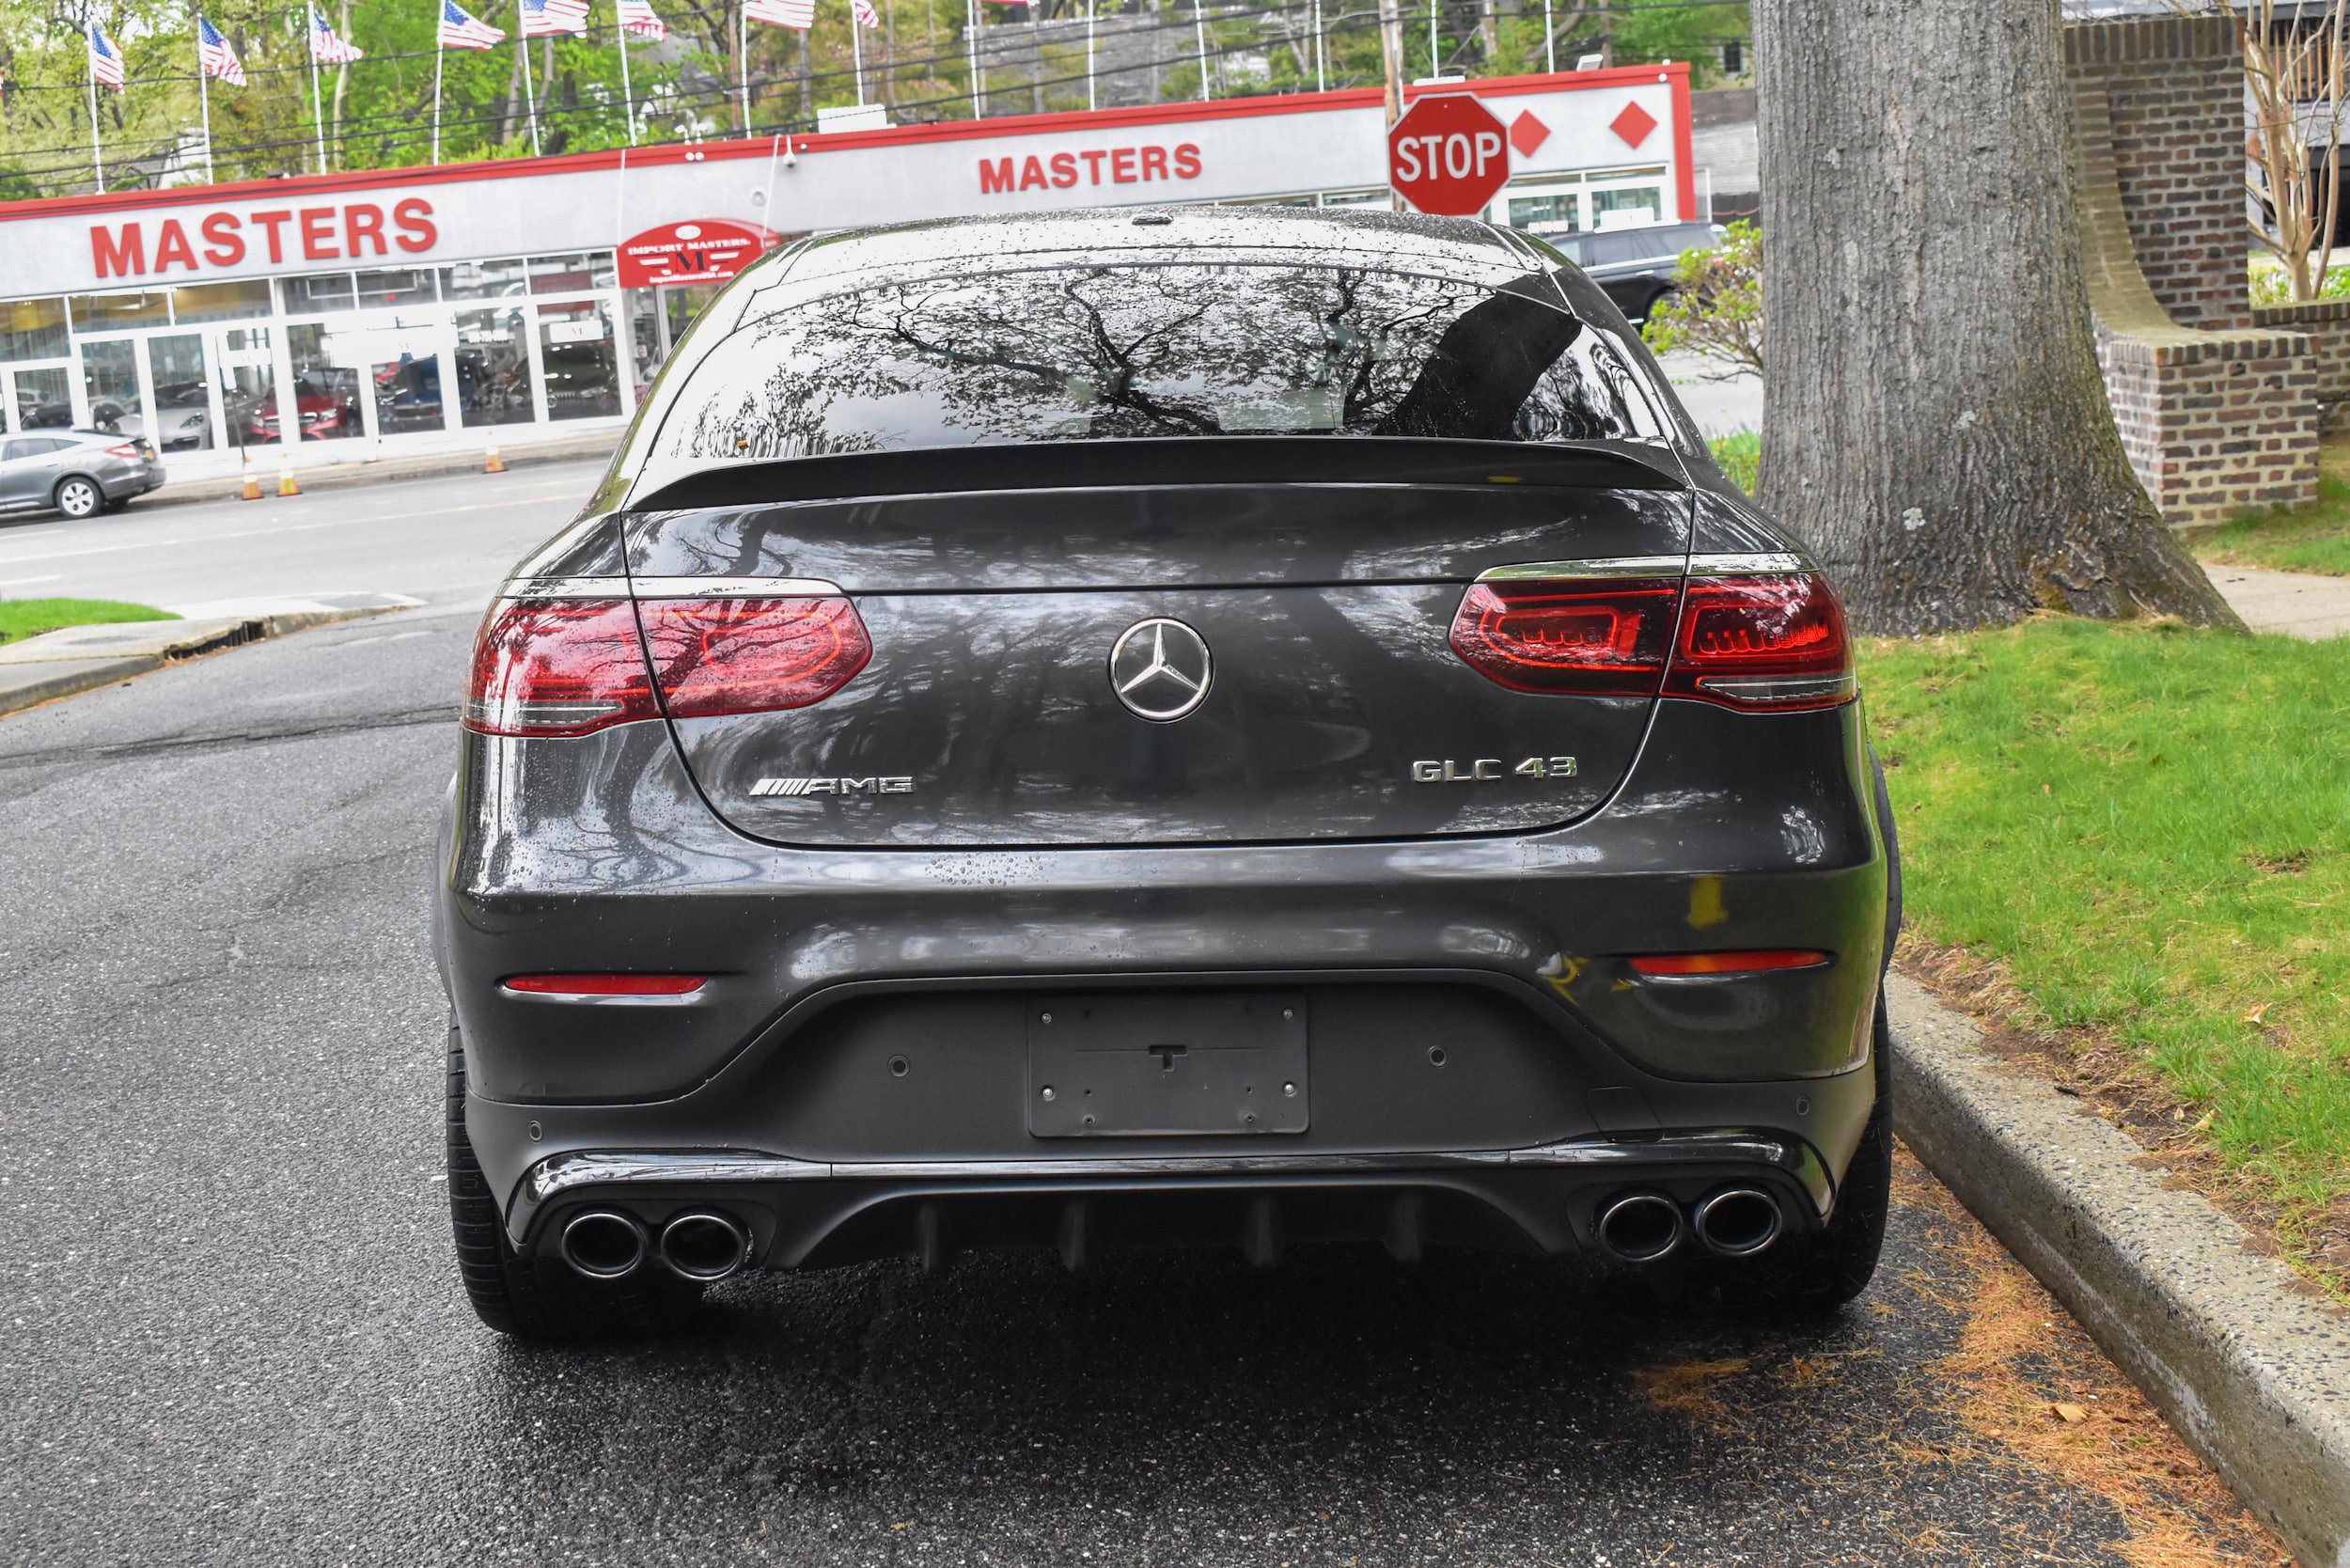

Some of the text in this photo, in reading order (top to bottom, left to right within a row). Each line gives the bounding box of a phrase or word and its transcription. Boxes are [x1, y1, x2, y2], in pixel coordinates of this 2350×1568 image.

[979, 143, 1202, 195] MASTERS
[1397, 132, 1501, 182] STOP
[89, 197, 438, 278] MASTERS
[628, 243, 684, 256] IMPORT
[676, 251, 705, 272] M
[1412, 757, 1577, 782] GLC 43
